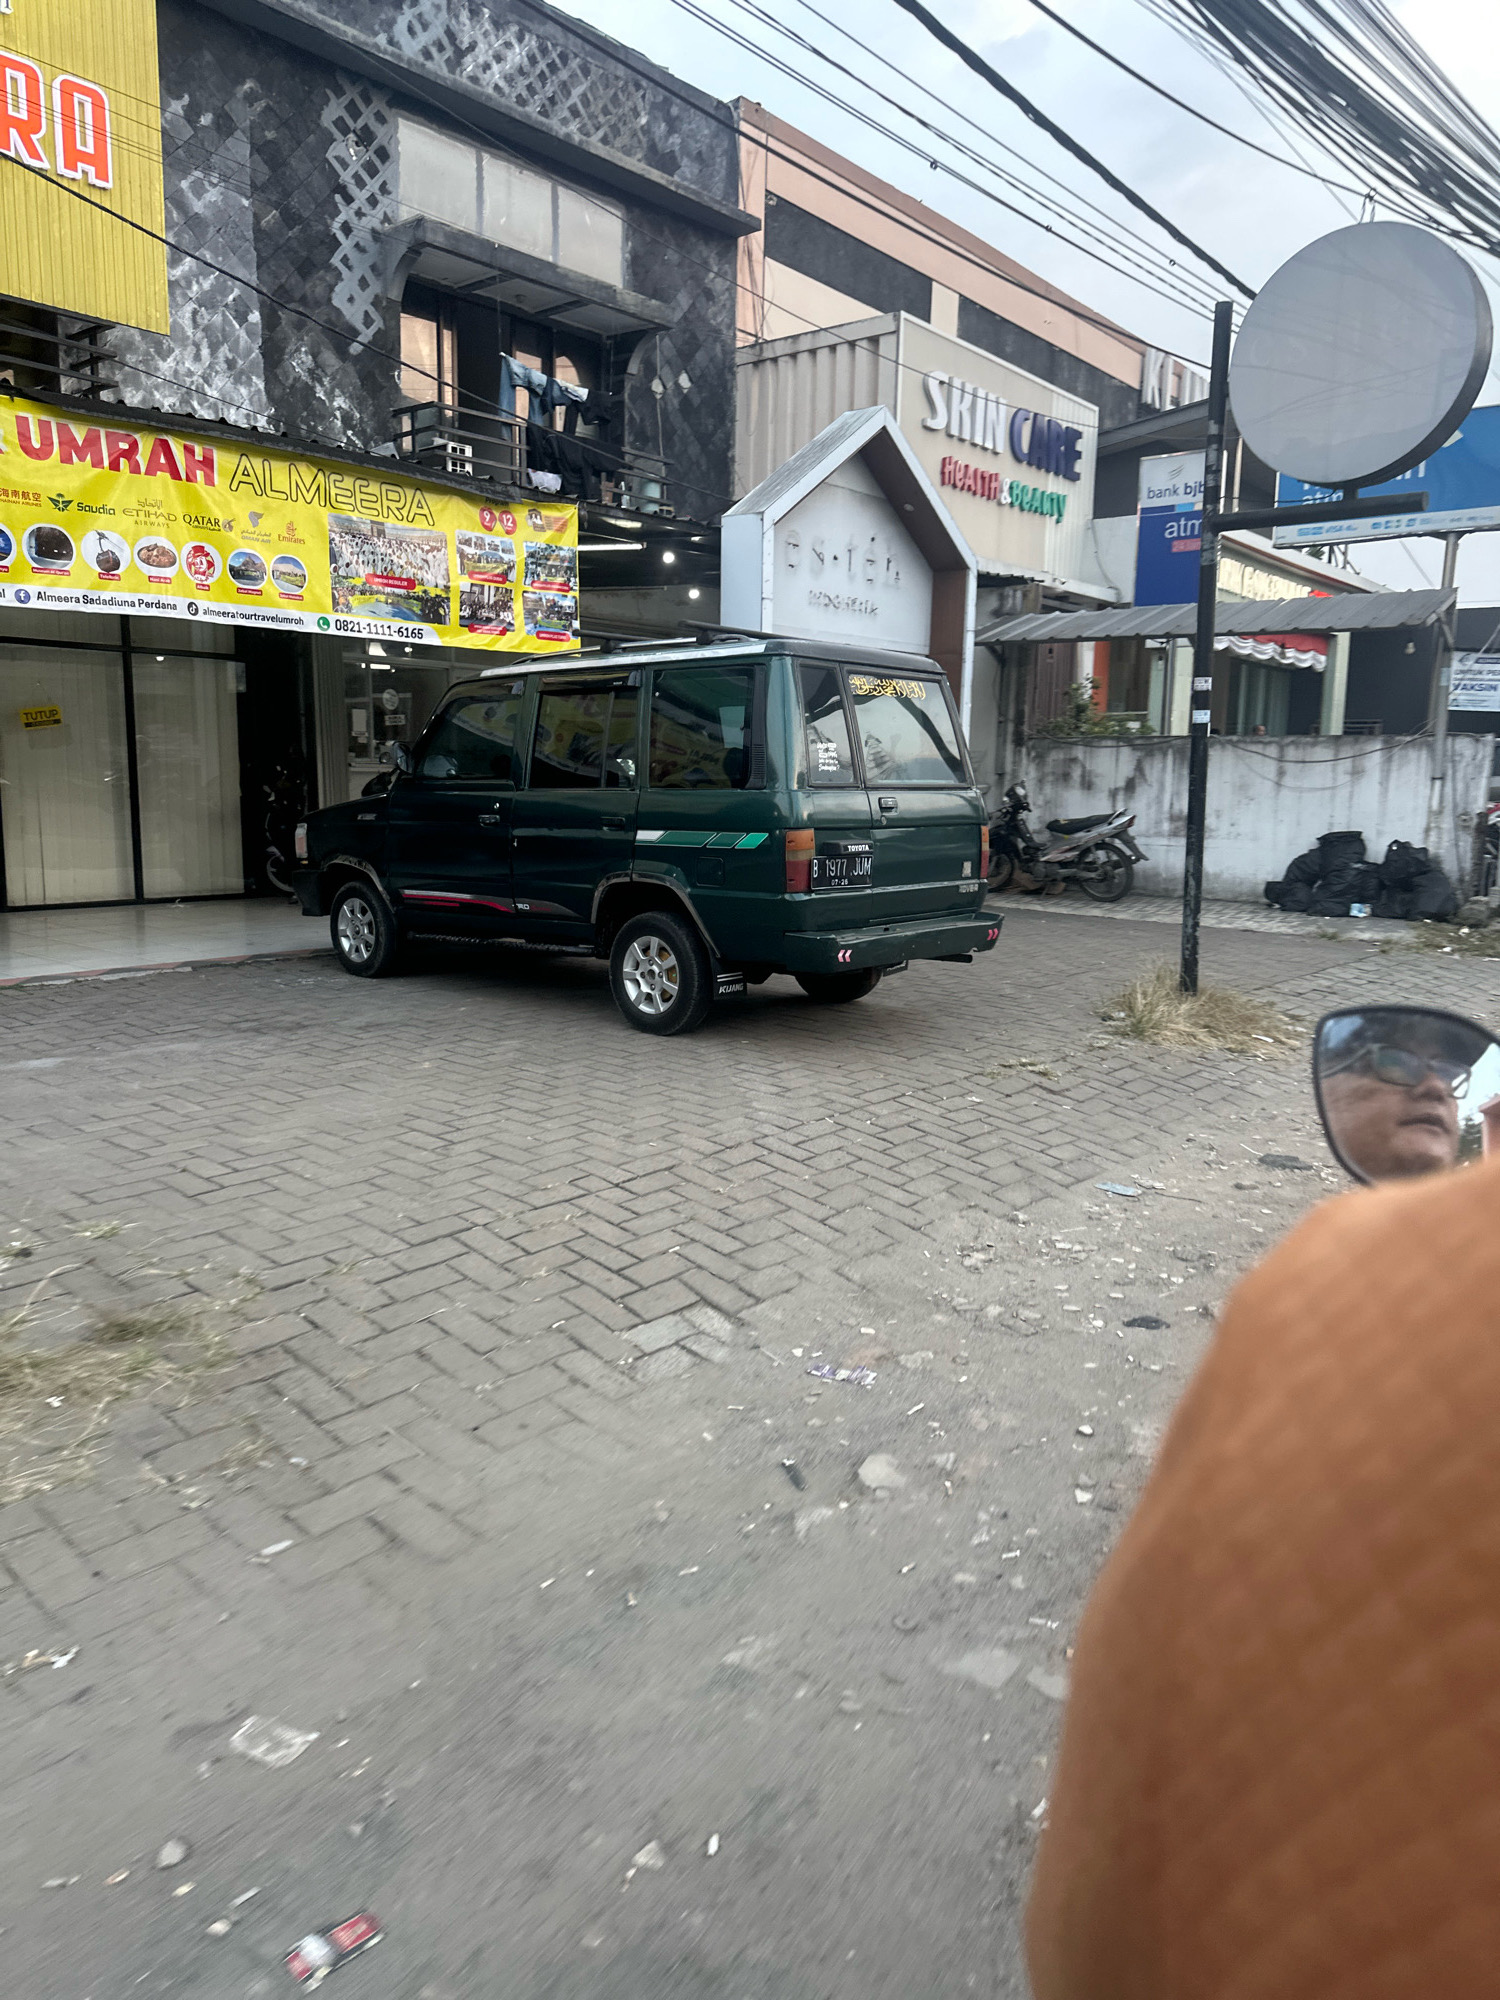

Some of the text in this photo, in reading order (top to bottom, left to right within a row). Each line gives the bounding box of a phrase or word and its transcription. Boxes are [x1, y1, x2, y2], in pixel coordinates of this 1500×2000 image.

[921, 371, 1083, 482] SKIN CARE
[14, 412, 218, 489] UMRAH
[229, 453, 436, 527] ALMEERA
[1146, 480, 1205, 499] bank bjb
[76, 501, 116, 516] Saudia
[122, 507, 178, 522] ETIHAD
[483, 510, 491, 521] 9
[134, 519, 171, 529] AIRWAYS
[182, 513, 221, 528] QATAR
[501, 514, 514, 527] 12
[277, 533, 306, 545] Emirates
[37, 591, 178, 611] Almeera Sadadiuna Perdana
[202, 606, 305, 626] almeeratourtravelumroh
[334, 618, 424, 640] 0821-1111-6165
[23, 708, 59, 721] TUTUP
[847, 844, 870, 853] TOYOTA
[813, 857, 872, 878] B 1977 JUM
[718, 982, 744, 994] KIJANG
